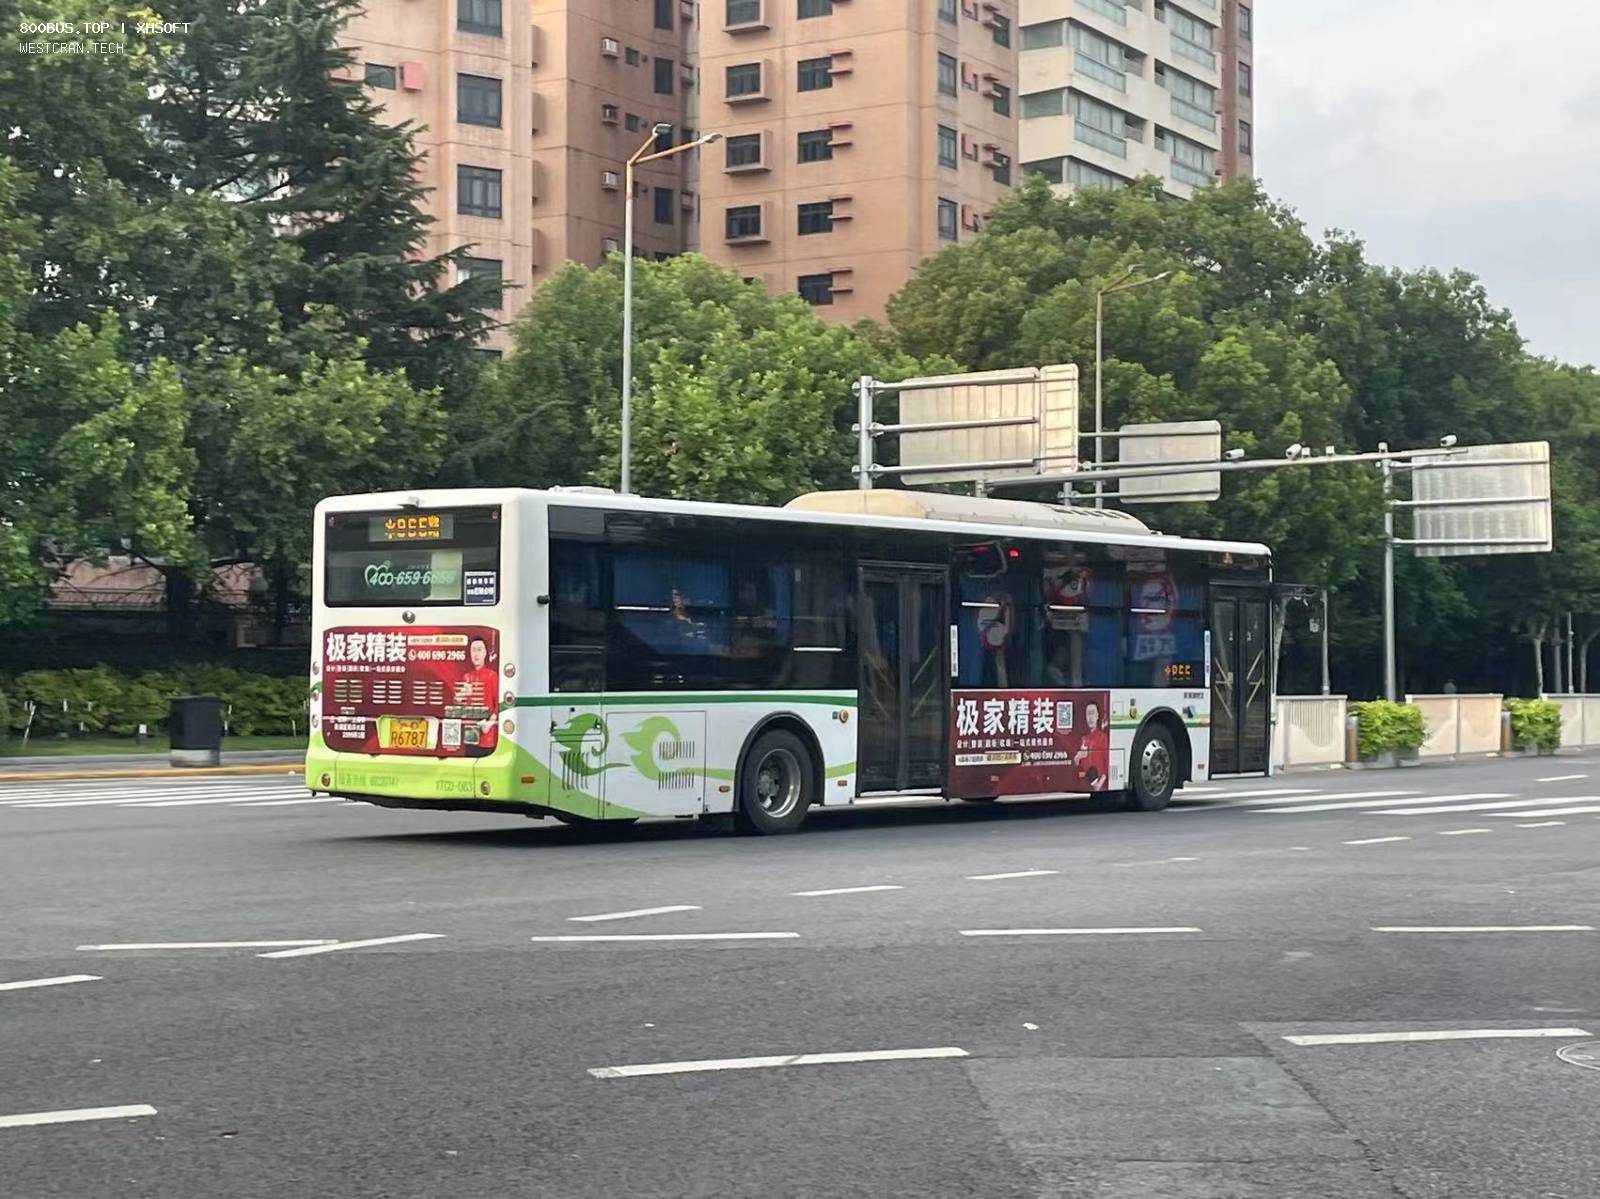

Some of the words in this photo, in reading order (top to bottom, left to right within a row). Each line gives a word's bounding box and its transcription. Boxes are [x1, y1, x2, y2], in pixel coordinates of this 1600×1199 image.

[326, 631, 407, 663] 极家精装
[417, 650, 431, 661] 400
[956, 697, 1055, 736] 极家精装
[391, 731, 425, 746] R6787
